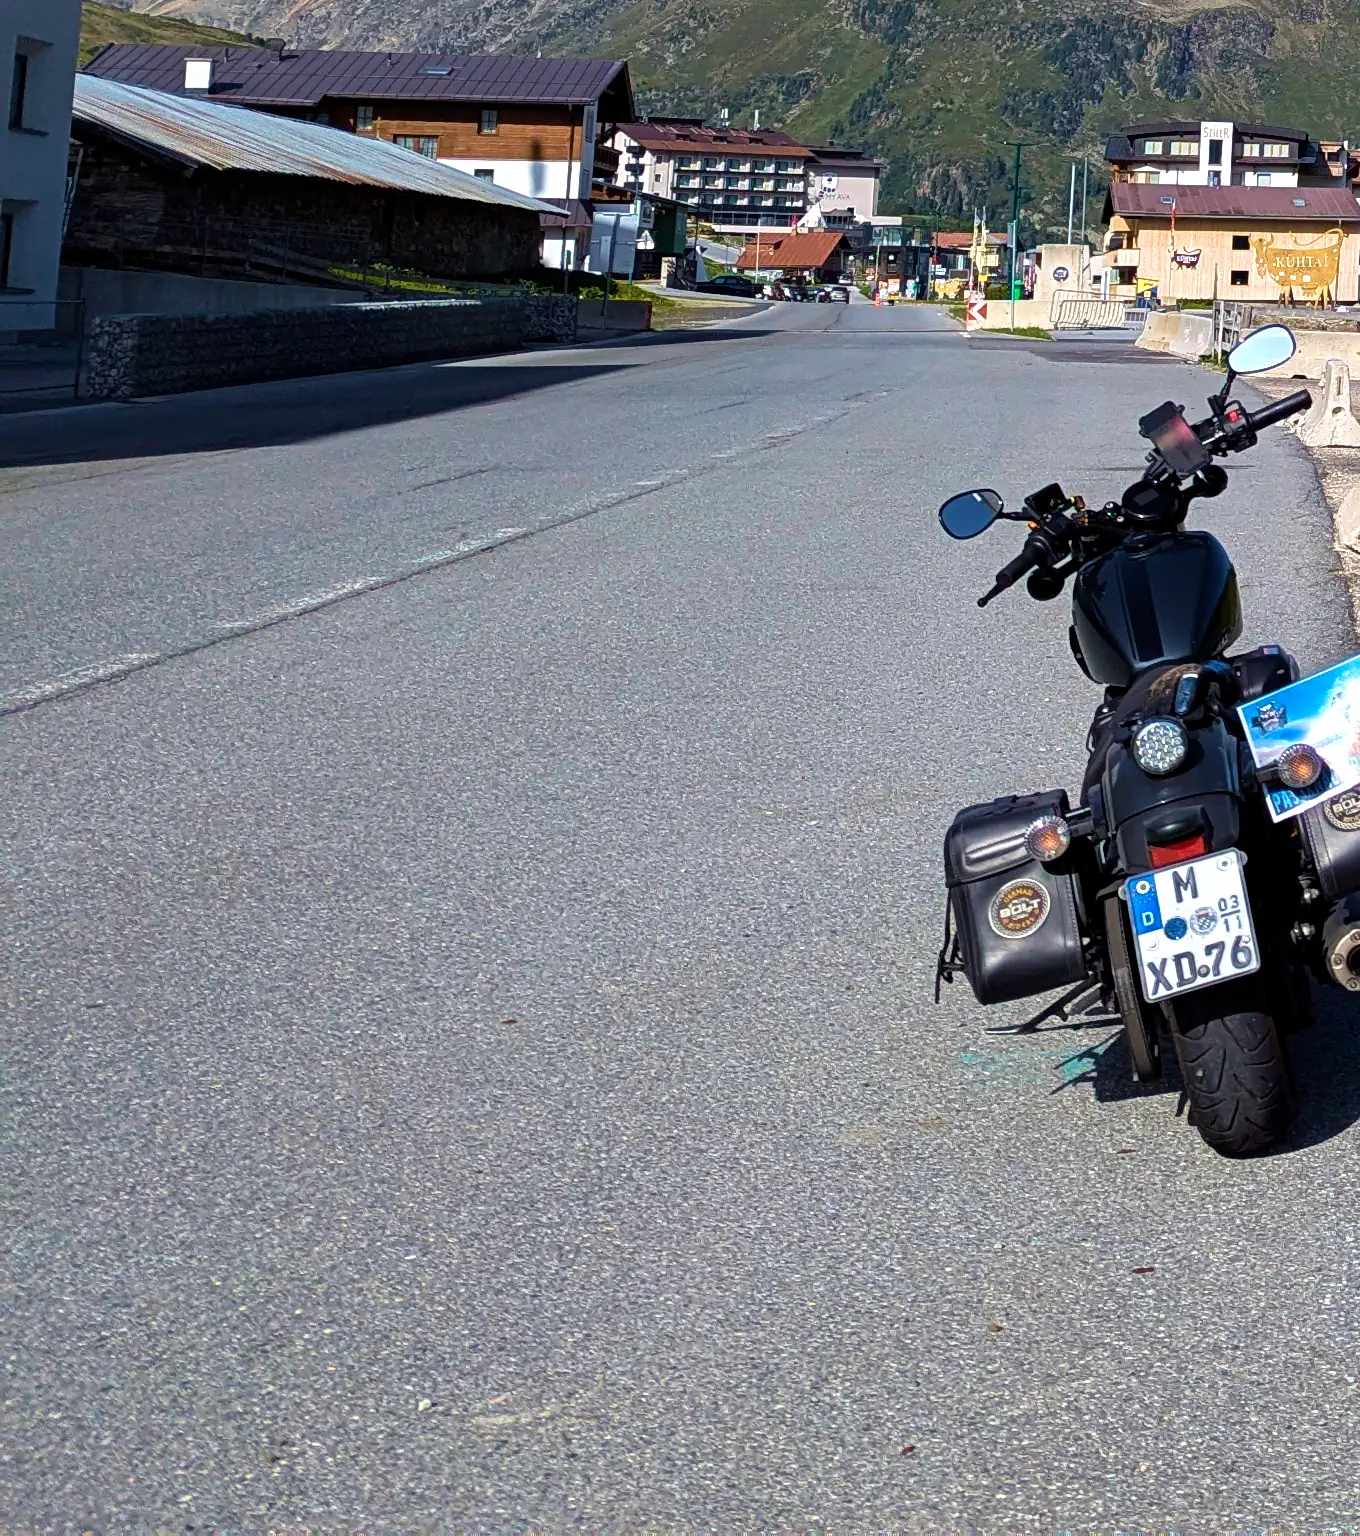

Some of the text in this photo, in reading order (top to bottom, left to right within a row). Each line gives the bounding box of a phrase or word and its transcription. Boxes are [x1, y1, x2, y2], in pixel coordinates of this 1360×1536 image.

[1171, 866, 1199, 903] M
[999, 898, 1041, 919] BOLT
[1217, 894, 1240, 912] 03
[1142, 911, 1155, 927] D
[1224, 915, 1243, 933] 11
